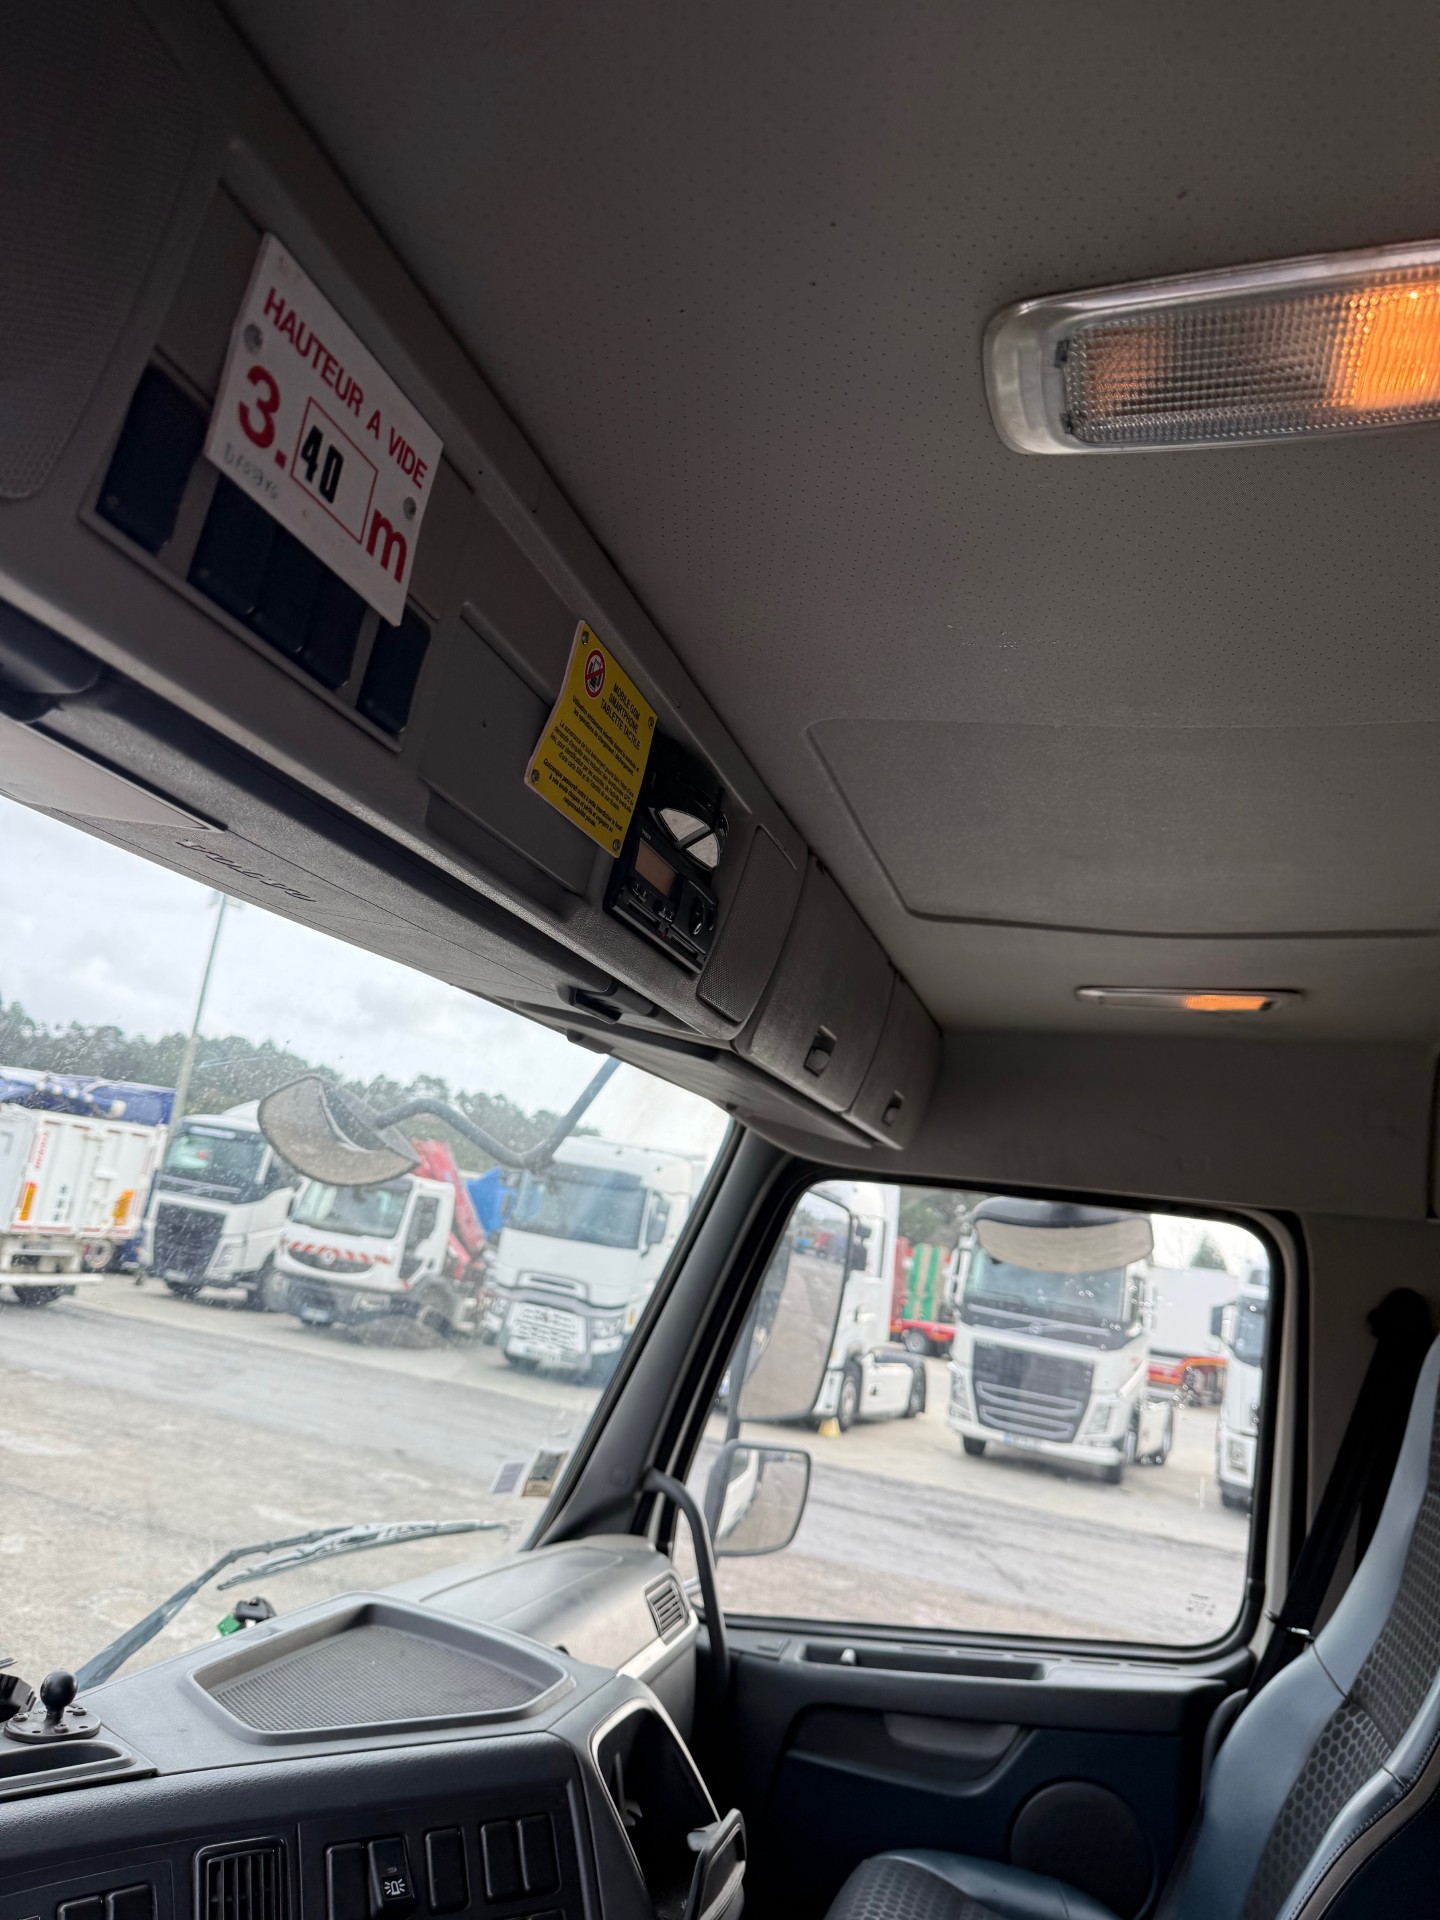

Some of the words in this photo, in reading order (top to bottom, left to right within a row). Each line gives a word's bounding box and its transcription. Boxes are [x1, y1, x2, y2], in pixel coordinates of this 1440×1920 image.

[263, 287, 364, 418] HAUTEUR
[366, 409, 381, 440] A
[389, 431, 429, 489] VIDE
[366, 509, 408, 583] m
[599, 698, 623, 730] TABLETTE
[622, 724, 640, 750] TACTILE
[608, 693, 638, 734] SMARTPHONE
[612, 682, 630, 709] MOBILE
[629, 703, 640, 721] GSM
